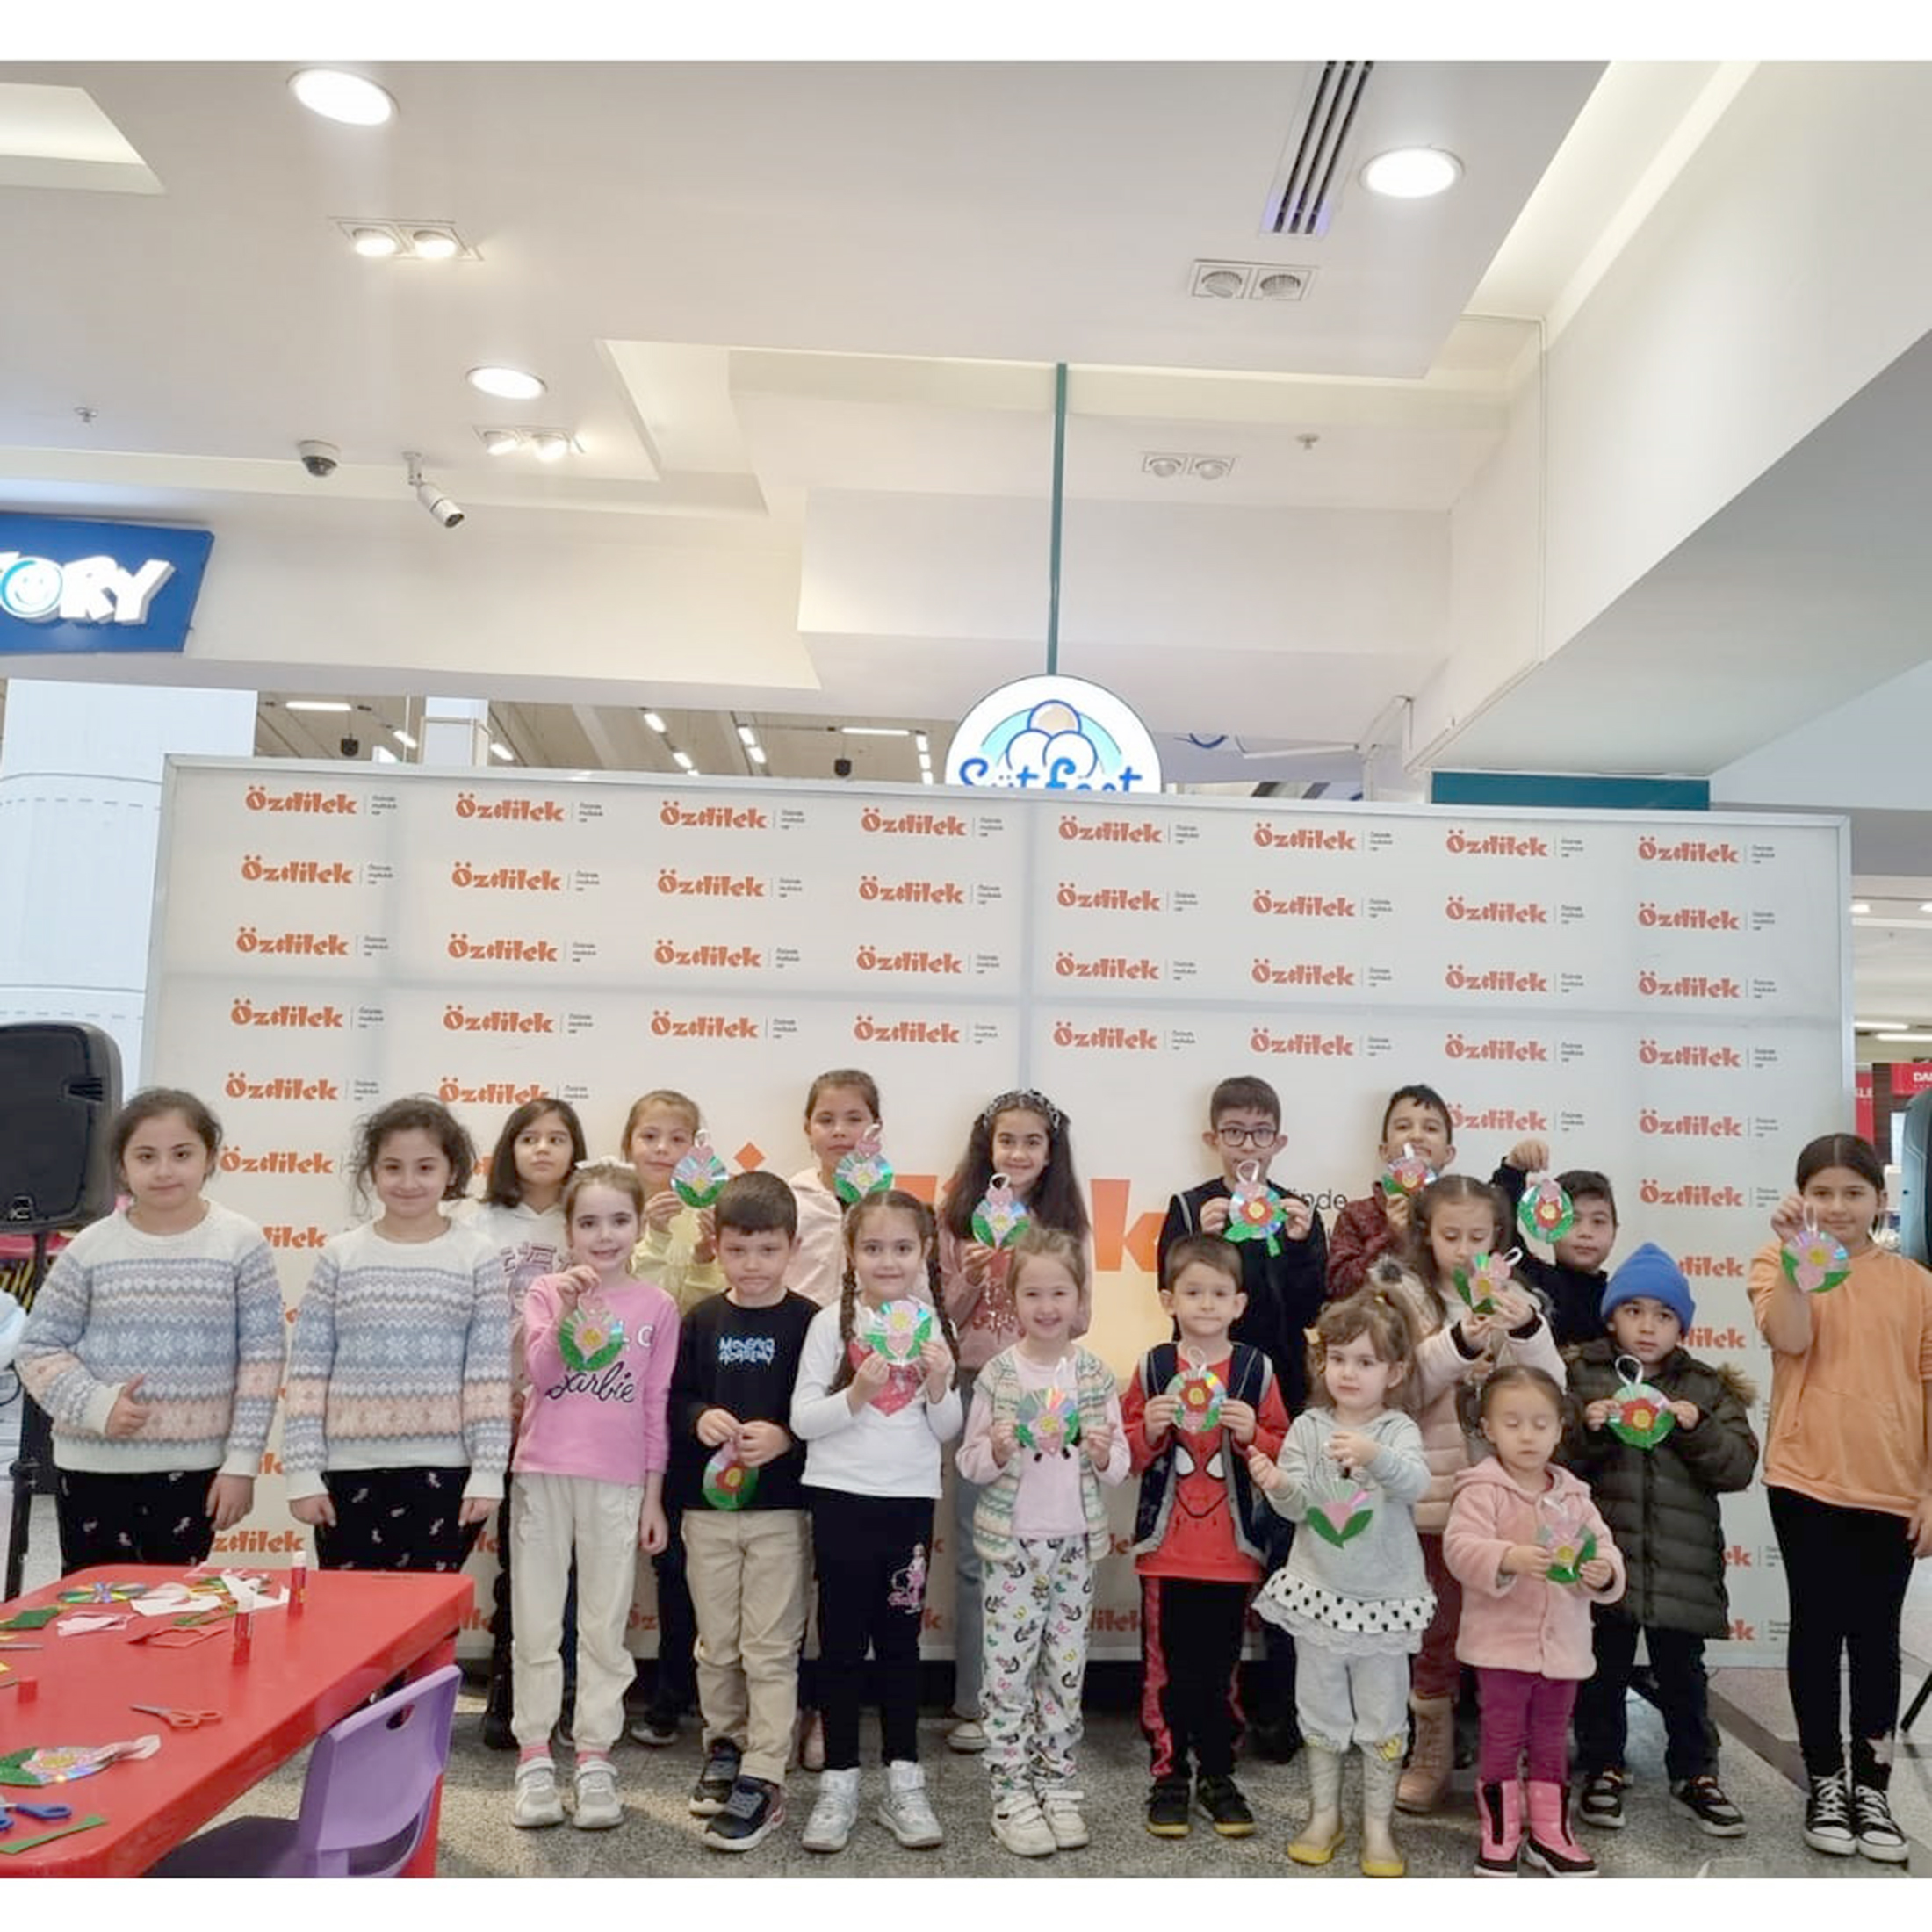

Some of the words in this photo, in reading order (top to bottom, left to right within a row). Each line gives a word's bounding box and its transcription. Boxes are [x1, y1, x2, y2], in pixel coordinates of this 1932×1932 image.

[246, 785, 357, 814] Özdilek
[456, 793, 564, 822] Özdilek
[660, 800, 767, 828] Özdilek
[861, 808, 965, 836] Özdilek
[1059, 815, 1162, 843] Özdilek
[1254, 822, 1355, 850] Özdilek
[1446, 829, 1547, 856] Özdilek
[1638, 836, 1738, 863] Özdilek
[242, 854, 353, 883] Özdilek
[452, 861, 560, 890] Özdilek
[658, 869, 764, 897] Özdilek
[859, 876, 963, 904] Özdilek
[1057, 883, 1160, 911] Özdilek
[1253, 890, 1354, 917] Özdilek
[1445, 896, 1546, 923] Özdilek
[1638, 903, 1739, 930] Özdilek
[236, 926, 348, 955] Özdilek
[448, 933, 558, 962] Özdilek
[654, 940, 761, 967] Özdilek
[856, 945, 962, 973] Özdilek
[1056, 952, 1159, 979] Özdilek
[1252, 959, 1354, 986] Özdilek
[1445, 965, 1546, 992] Özdilek
[1638, 970, 1739, 998] Özdilek
[231, 998, 343, 1027] Özdilek
[443, 1005, 553, 1033] Özdilek
[651, 1010, 758, 1038] Özdilek
[854, 1015, 959, 1043] Özdilek
[1054, 1021, 1157, 1049] Özdilek
[1251, 1027, 1353, 1056] Özdilek
[1445, 1034, 1546, 1061] Özdilek
[1639, 1040, 1740, 1067] Özdilek
[225, 1072, 338, 1100] Özdilek
[438, 1077, 550, 1104] Özdilek
[1640, 1109, 1741, 1137] Özdilek
[220, 1146, 333, 1174] Özdilek
[1640, 1179, 1742, 1207] Özdilek
[1678, 1257, 1744, 1277] dilek
[1681, 1328, 1747, 1348] dilek
[213, 1530, 305, 1554] zdilek
